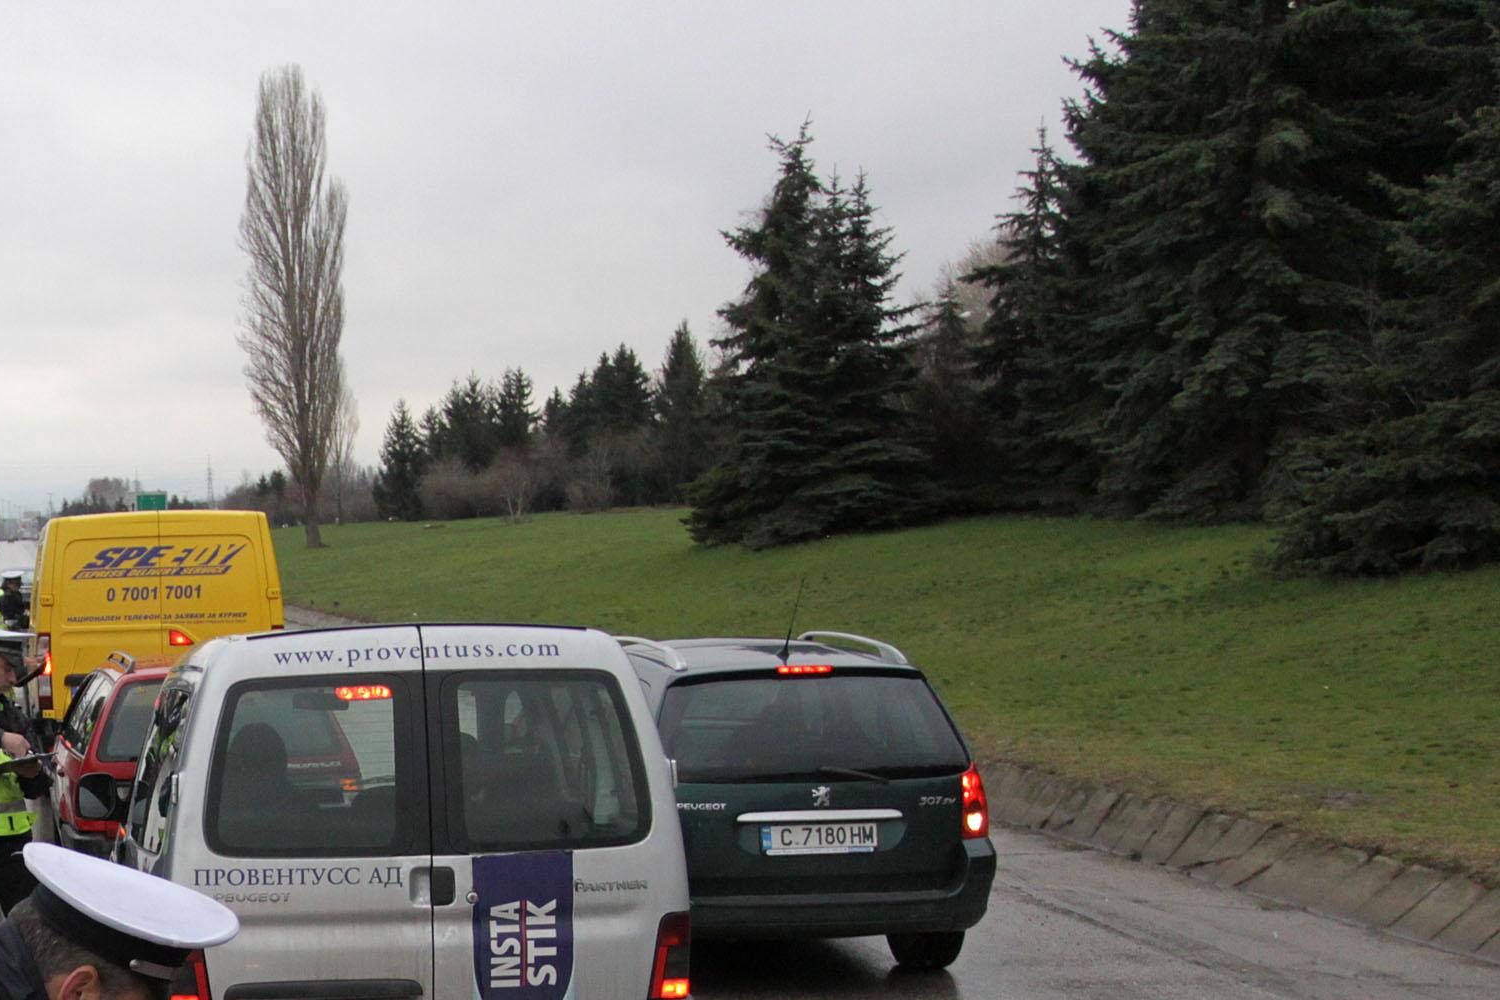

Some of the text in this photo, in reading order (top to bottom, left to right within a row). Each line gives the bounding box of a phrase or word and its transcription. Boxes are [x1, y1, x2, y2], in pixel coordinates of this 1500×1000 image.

[107, 585, 202, 601] 0 7001 7001
[67, 615, 121, 623] НАЦИОНАЛЕН
[124, 614, 160, 622] ТЕЛЕФОН
[274, 642, 561, 667] www.proventuss.com
[676, 802, 727, 811] PEUGEOT
[802, 826, 846, 846] 7180
[194, 867, 403, 888] ПРОВЕНТУСС АД
[489, 900, 521, 988] INSTA
[526, 898, 557, 986] STIK
